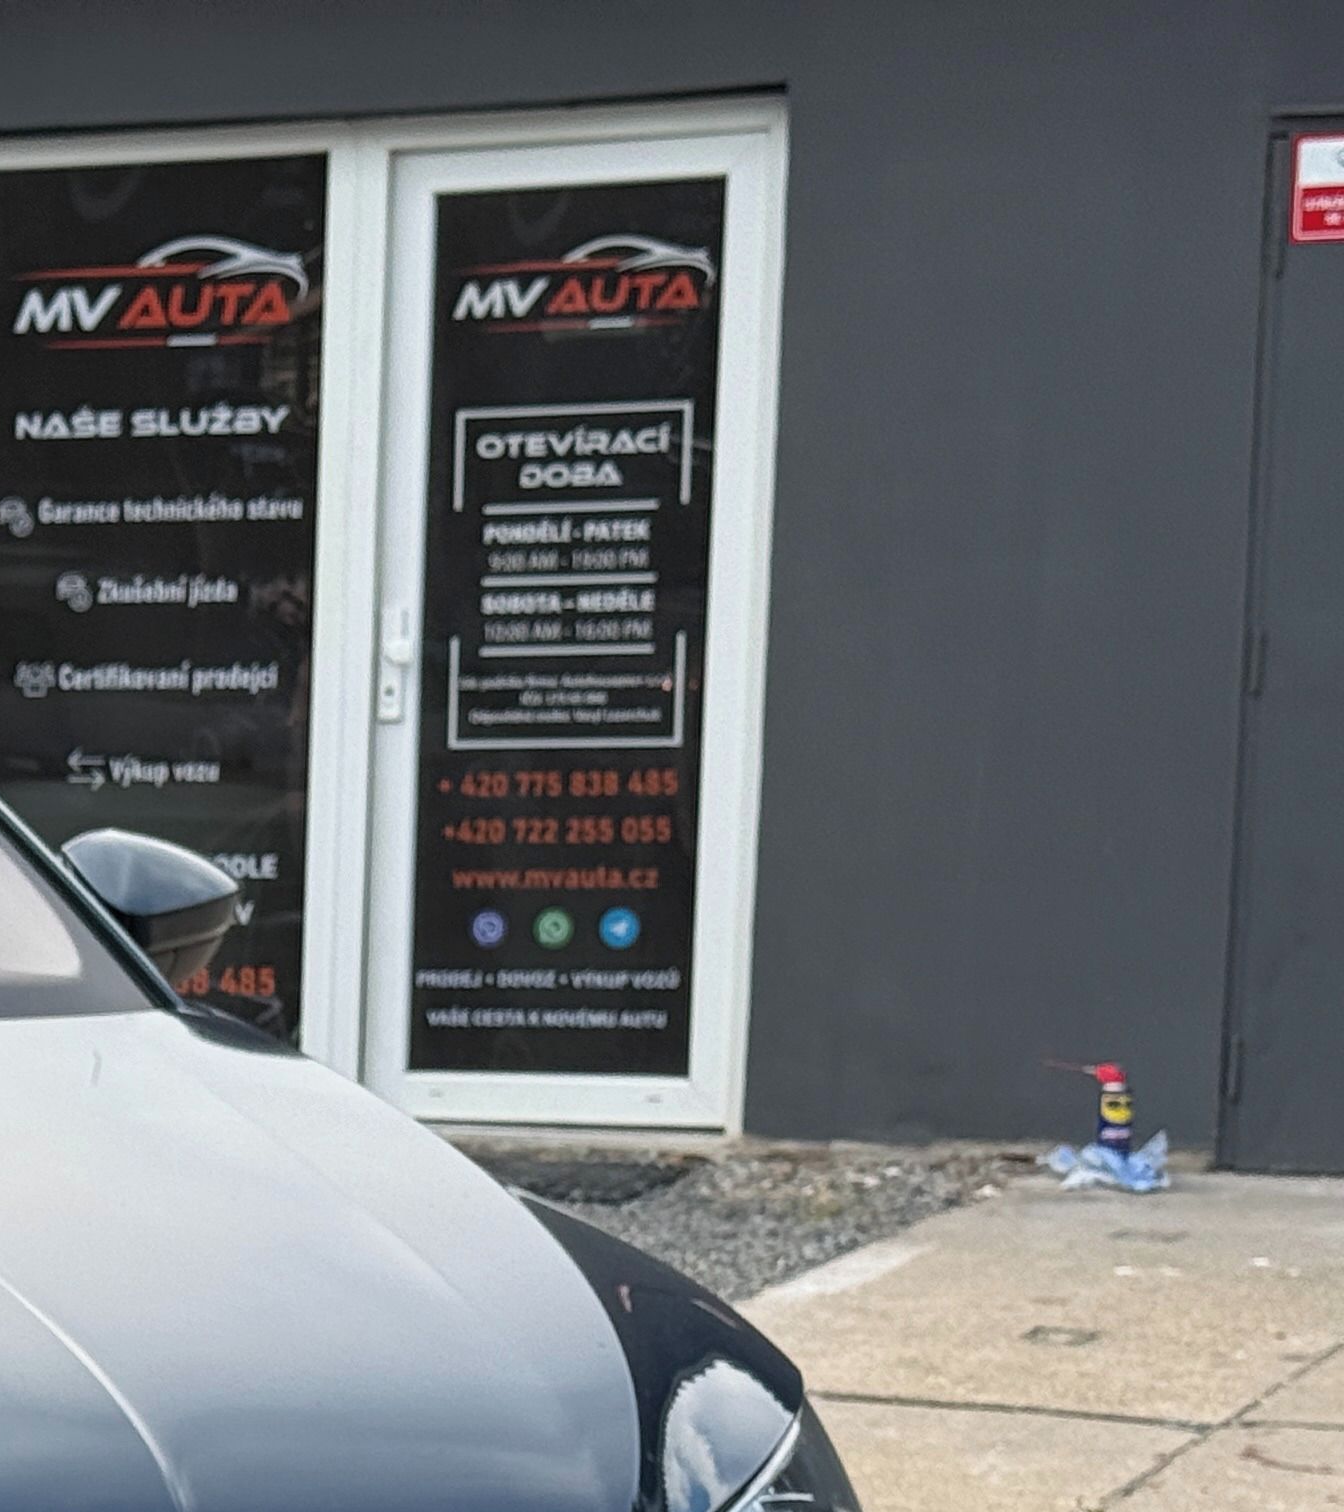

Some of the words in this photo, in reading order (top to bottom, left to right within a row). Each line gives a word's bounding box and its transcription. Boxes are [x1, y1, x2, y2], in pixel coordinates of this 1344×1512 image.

[13, 285, 122, 334] MV
[118, 281, 291, 329] AUTA
[452, 276, 550, 321] MV
[546, 271, 699, 316] AUTA
[15, 404, 123, 440] NAŠE
[131, 401, 290, 438] SLUŽBY
[476, 422, 670, 459] OTEVÍRACÍ
[519, 460, 623, 489] DOBA
[460, 771, 509, 797] 420
[515, 770, 562, 797] 775
[513, 817, 559, 844] 722
[452, 866, 658, 888] www.mvauta.cz
[219, 965, 275, 996] 485
